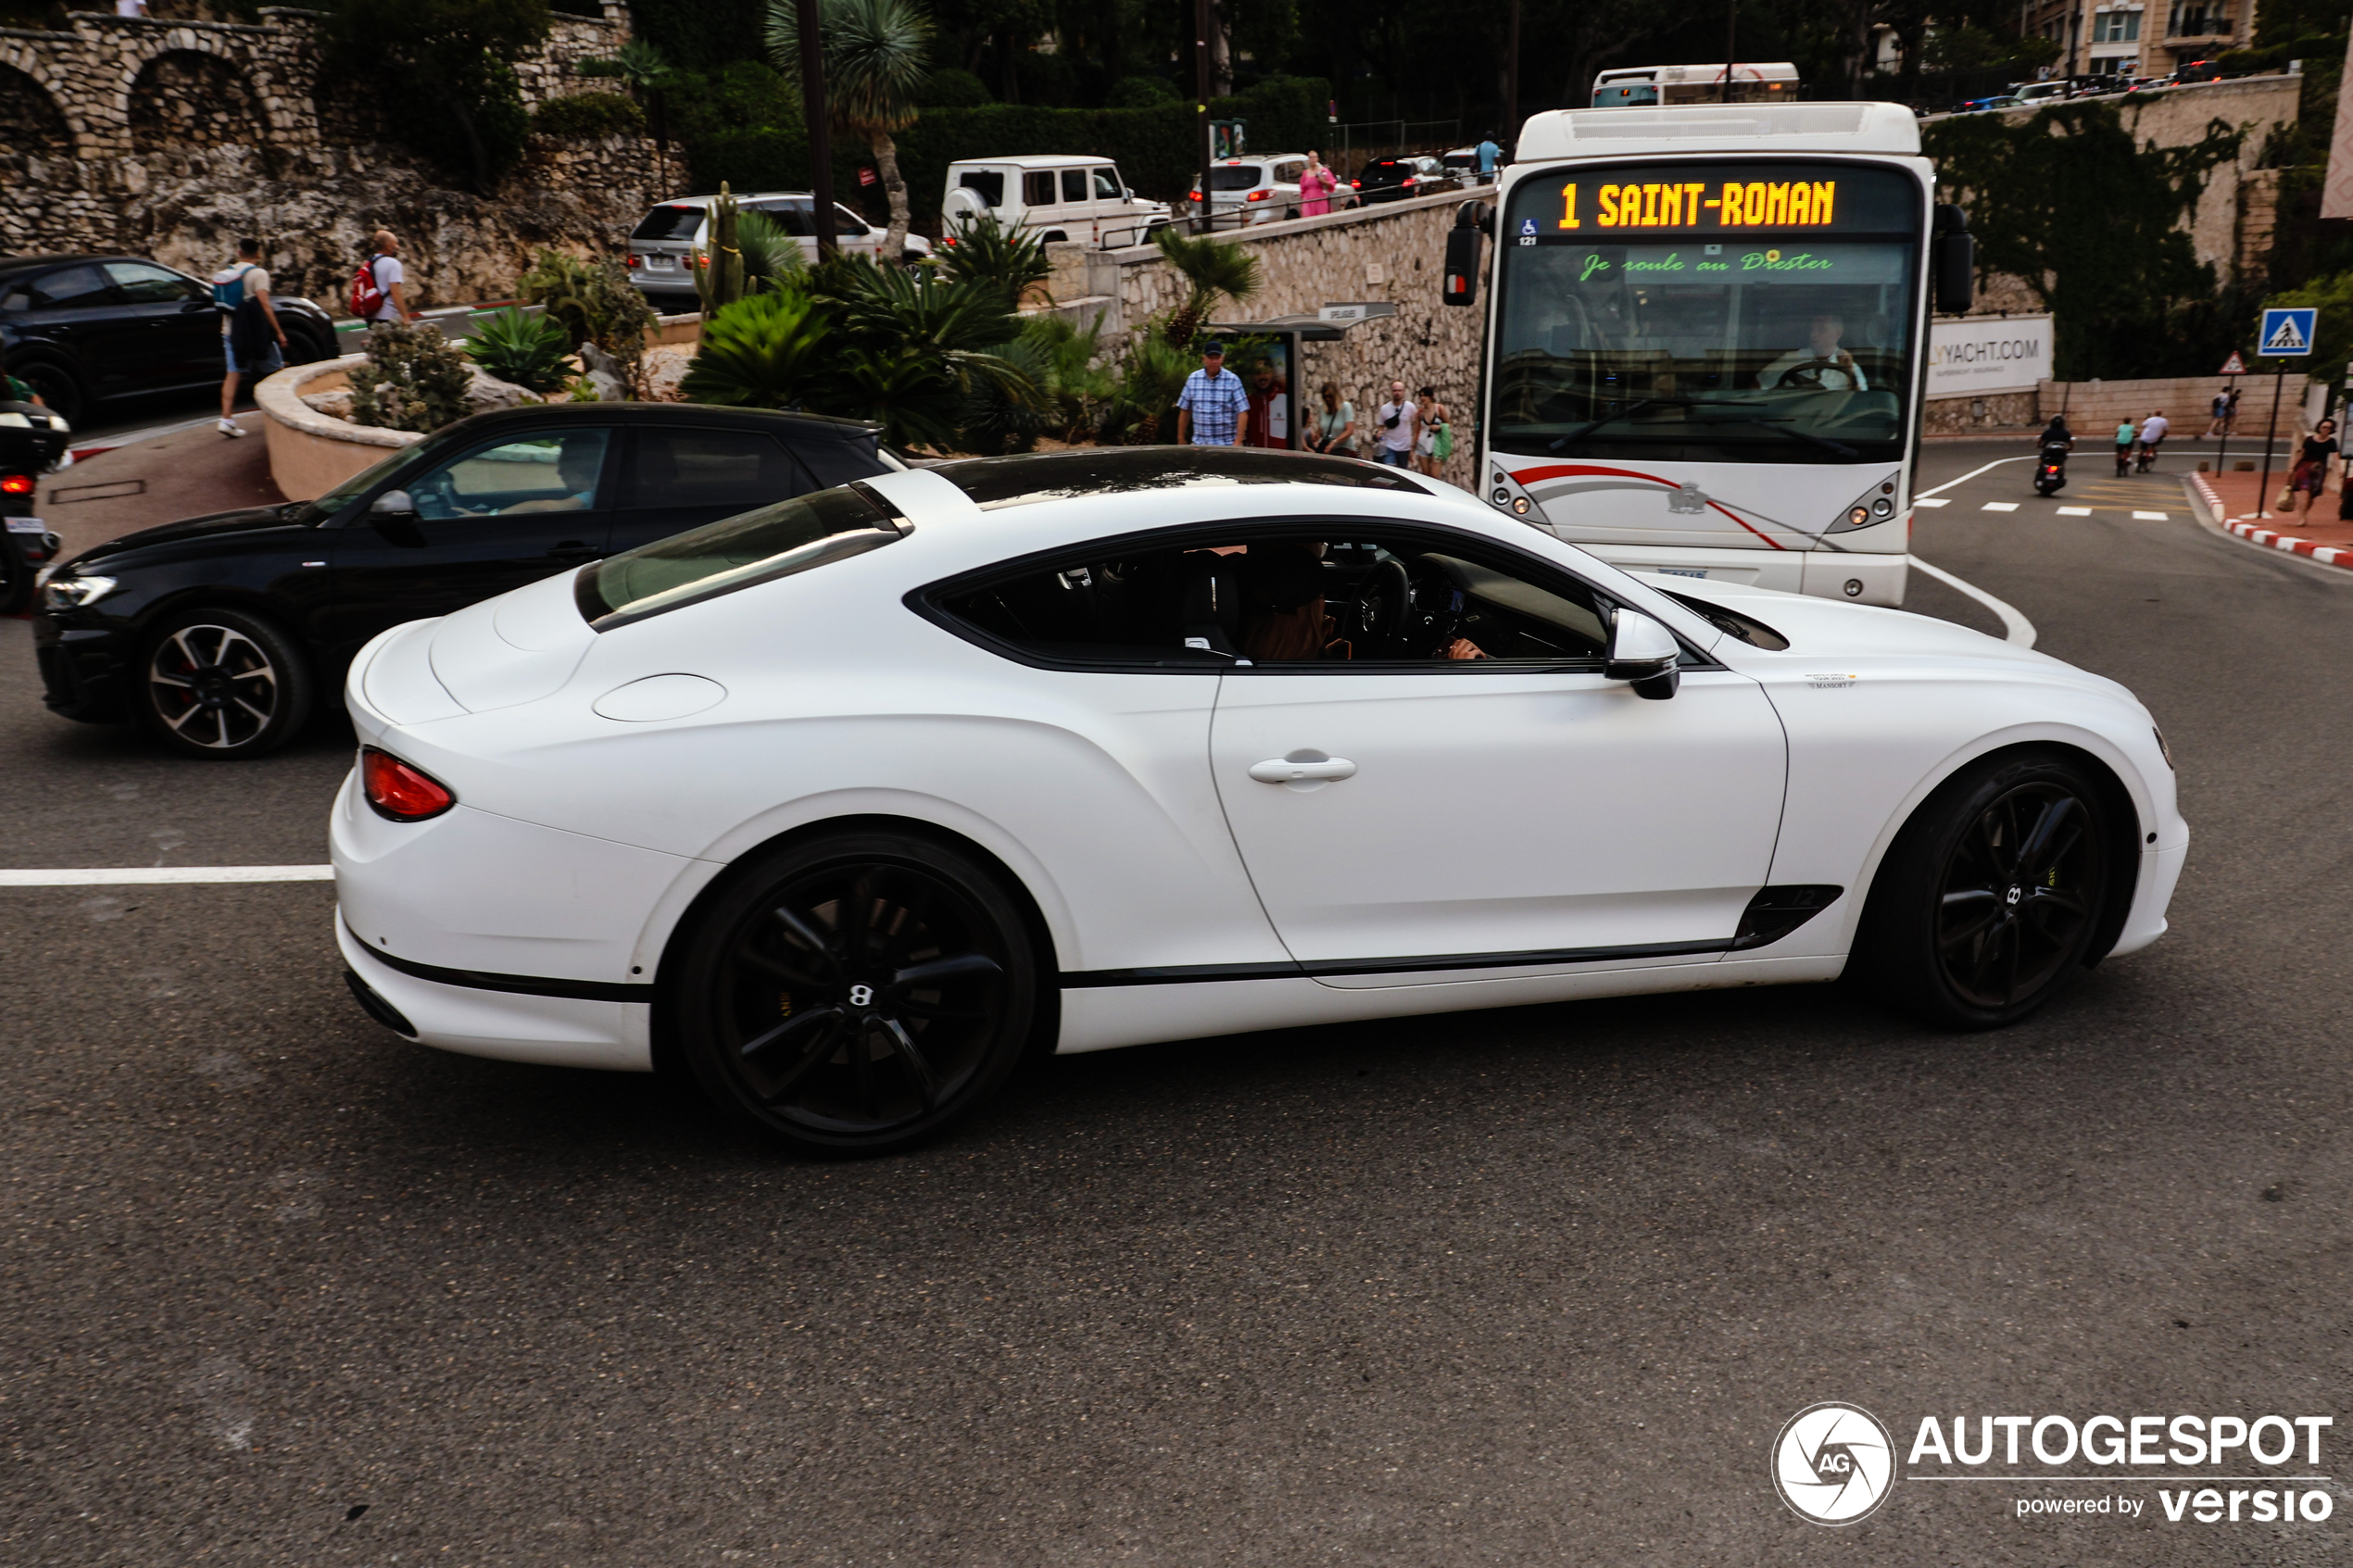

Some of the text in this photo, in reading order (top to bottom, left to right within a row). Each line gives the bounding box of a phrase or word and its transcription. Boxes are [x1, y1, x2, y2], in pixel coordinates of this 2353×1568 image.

[1559, 181, 1836, 229] 1 SAINT-ROMAN
[1519, 236, 1537, 246] 121
[1579, 249, 1833, 282] Je roule au Diester
